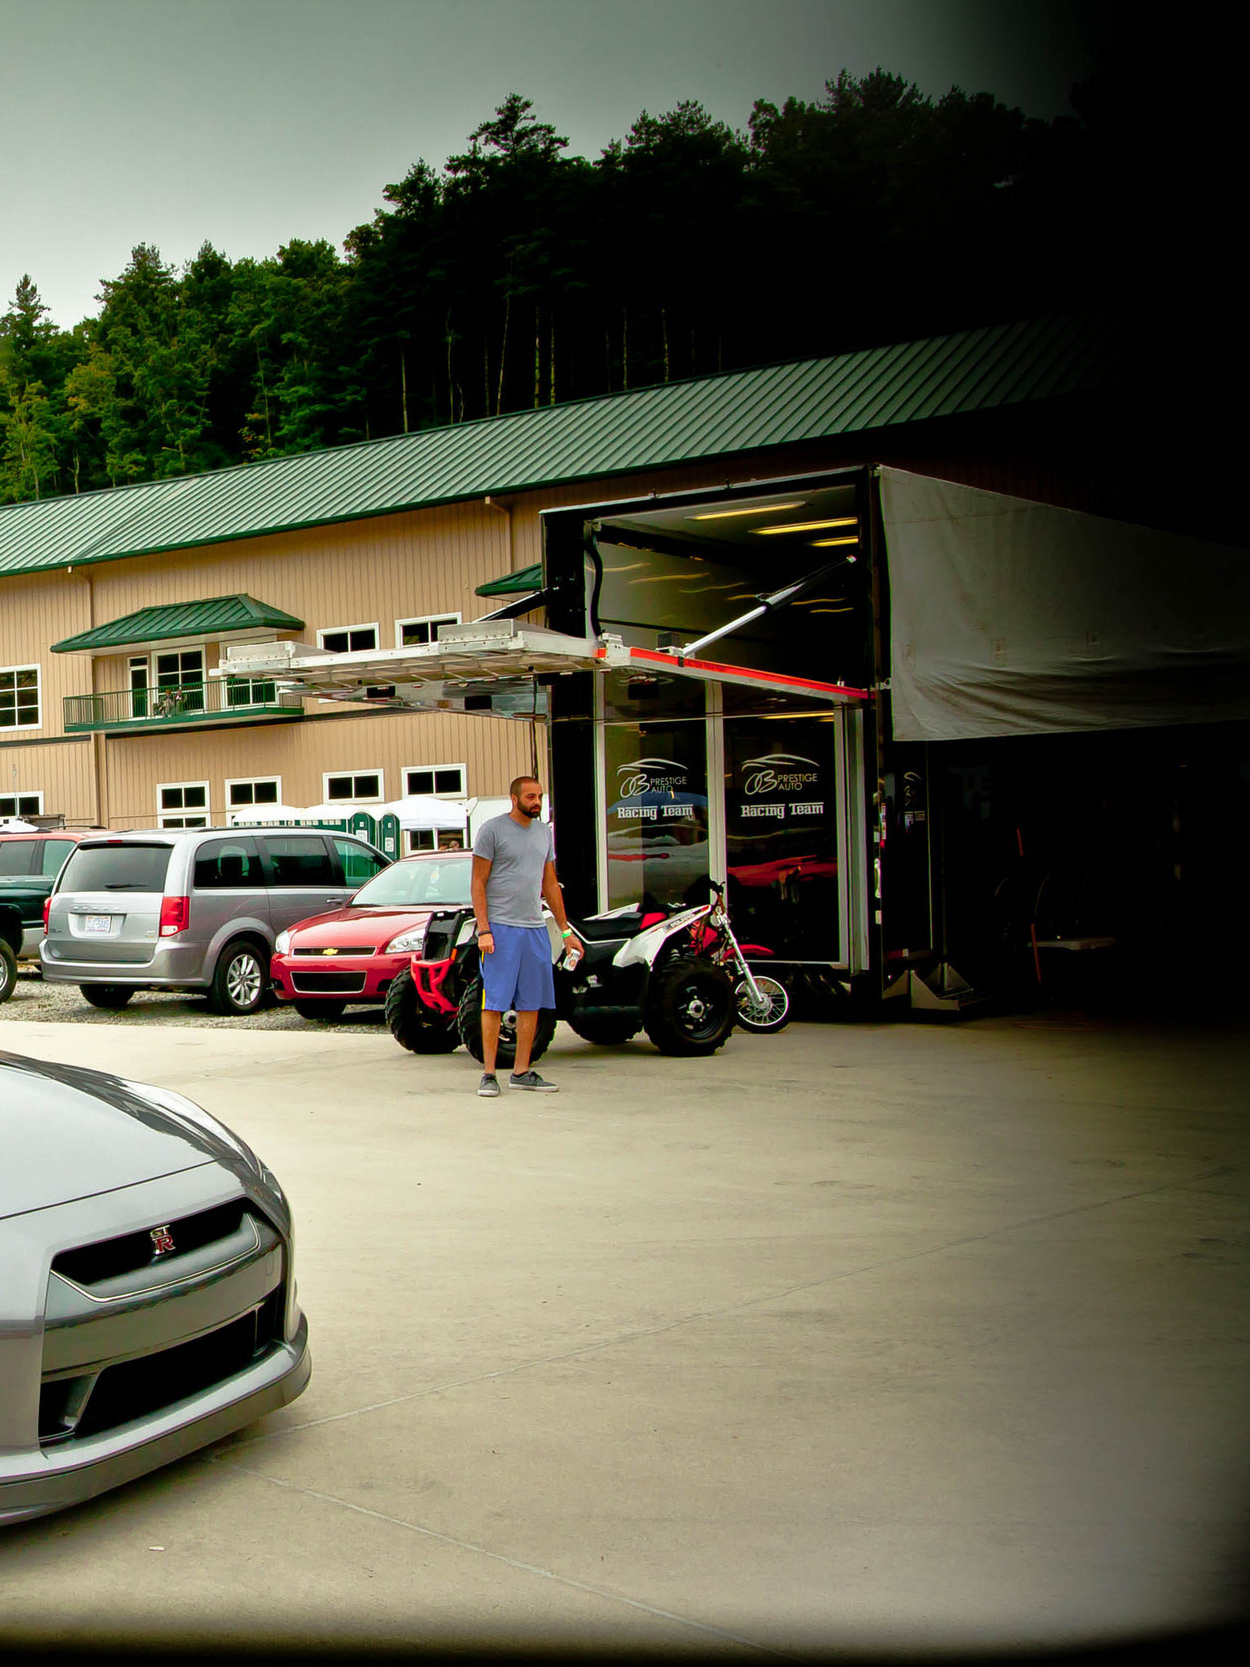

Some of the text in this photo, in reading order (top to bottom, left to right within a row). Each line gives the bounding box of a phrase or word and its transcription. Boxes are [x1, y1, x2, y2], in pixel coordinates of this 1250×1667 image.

[650, 776, 688, 786] PRESTIGE
[777, 773, 818, 783] PRESTIGE
[651, 785, 674, 794] AUTO
[778, 782, 803, 791] AUTO
[616, 804, 694, 821] Racing Team
[740, 801, 825, 819] Racing Team
